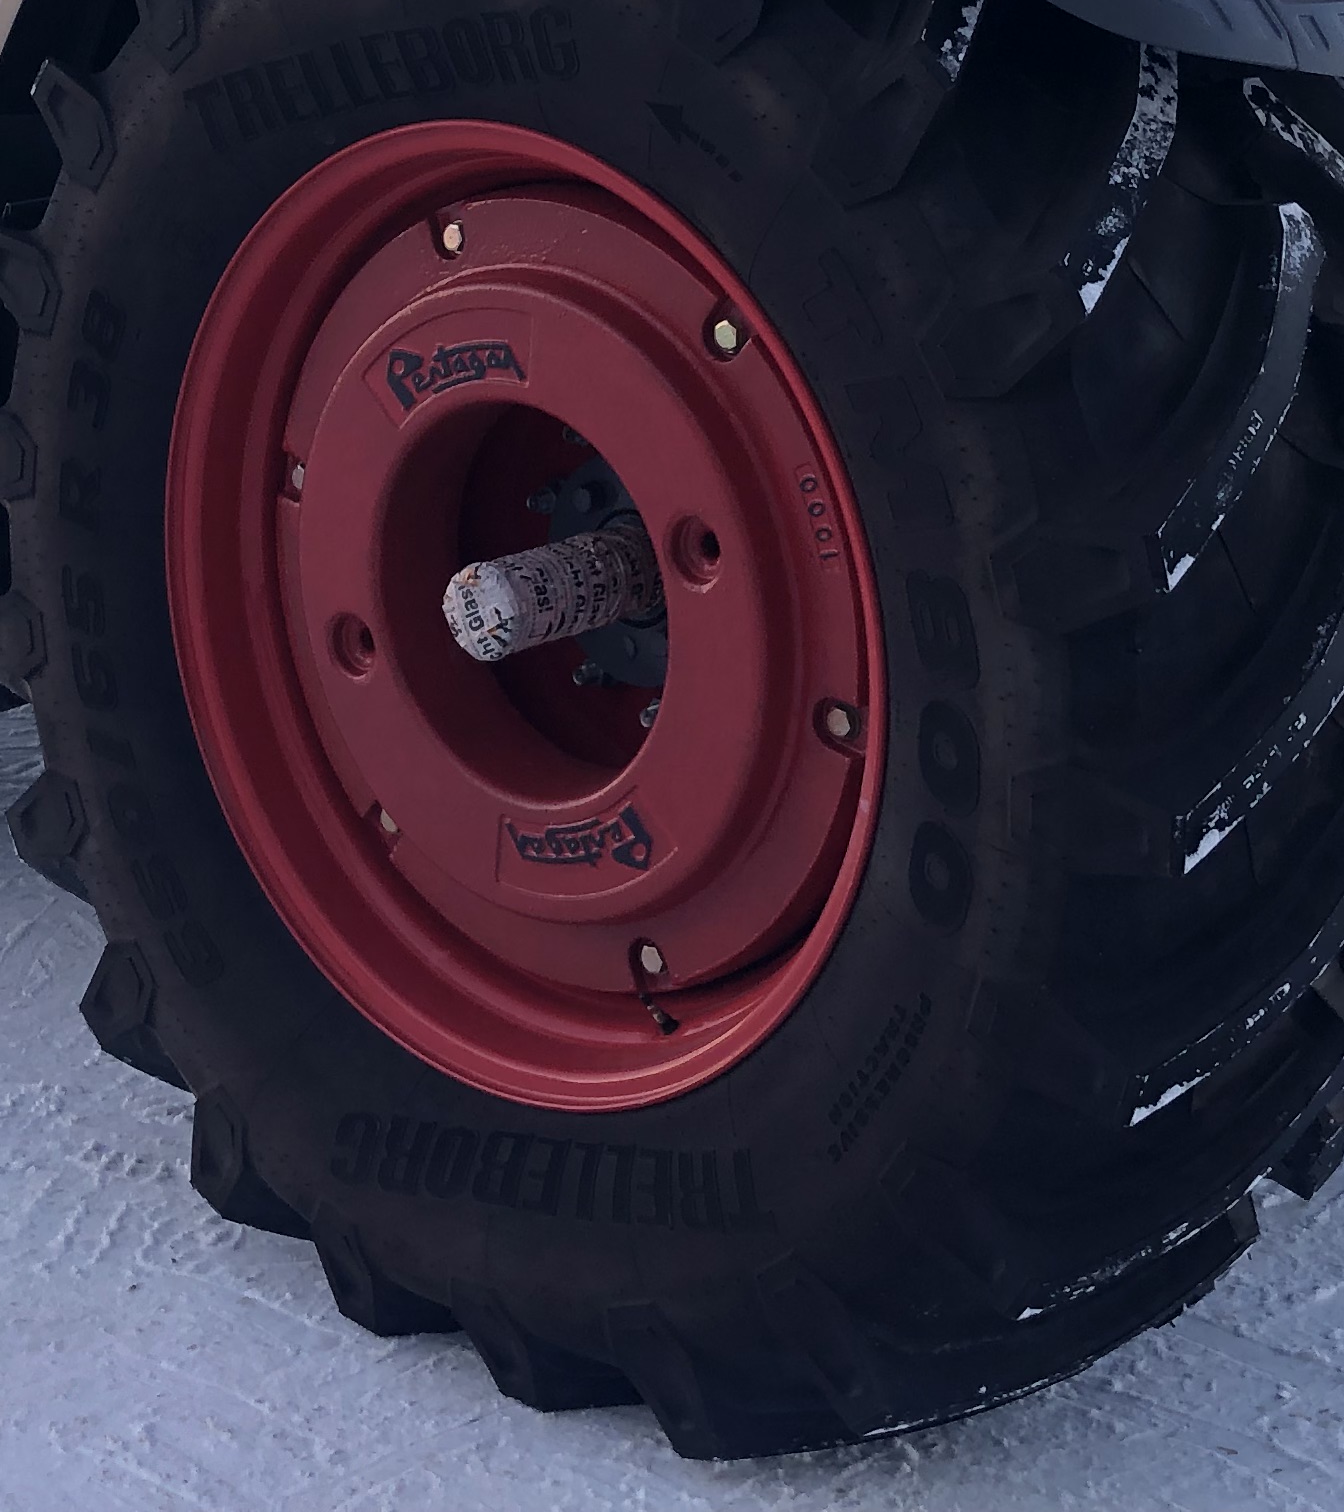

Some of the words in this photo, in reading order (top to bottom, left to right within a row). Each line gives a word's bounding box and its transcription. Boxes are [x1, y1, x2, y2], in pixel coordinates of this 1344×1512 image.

[182, 4, 582, 152] TRELLEBORG
[386, 341, 527, 410] Pentagon
[328, 1112, 779, 1238] TRELLEBORG
